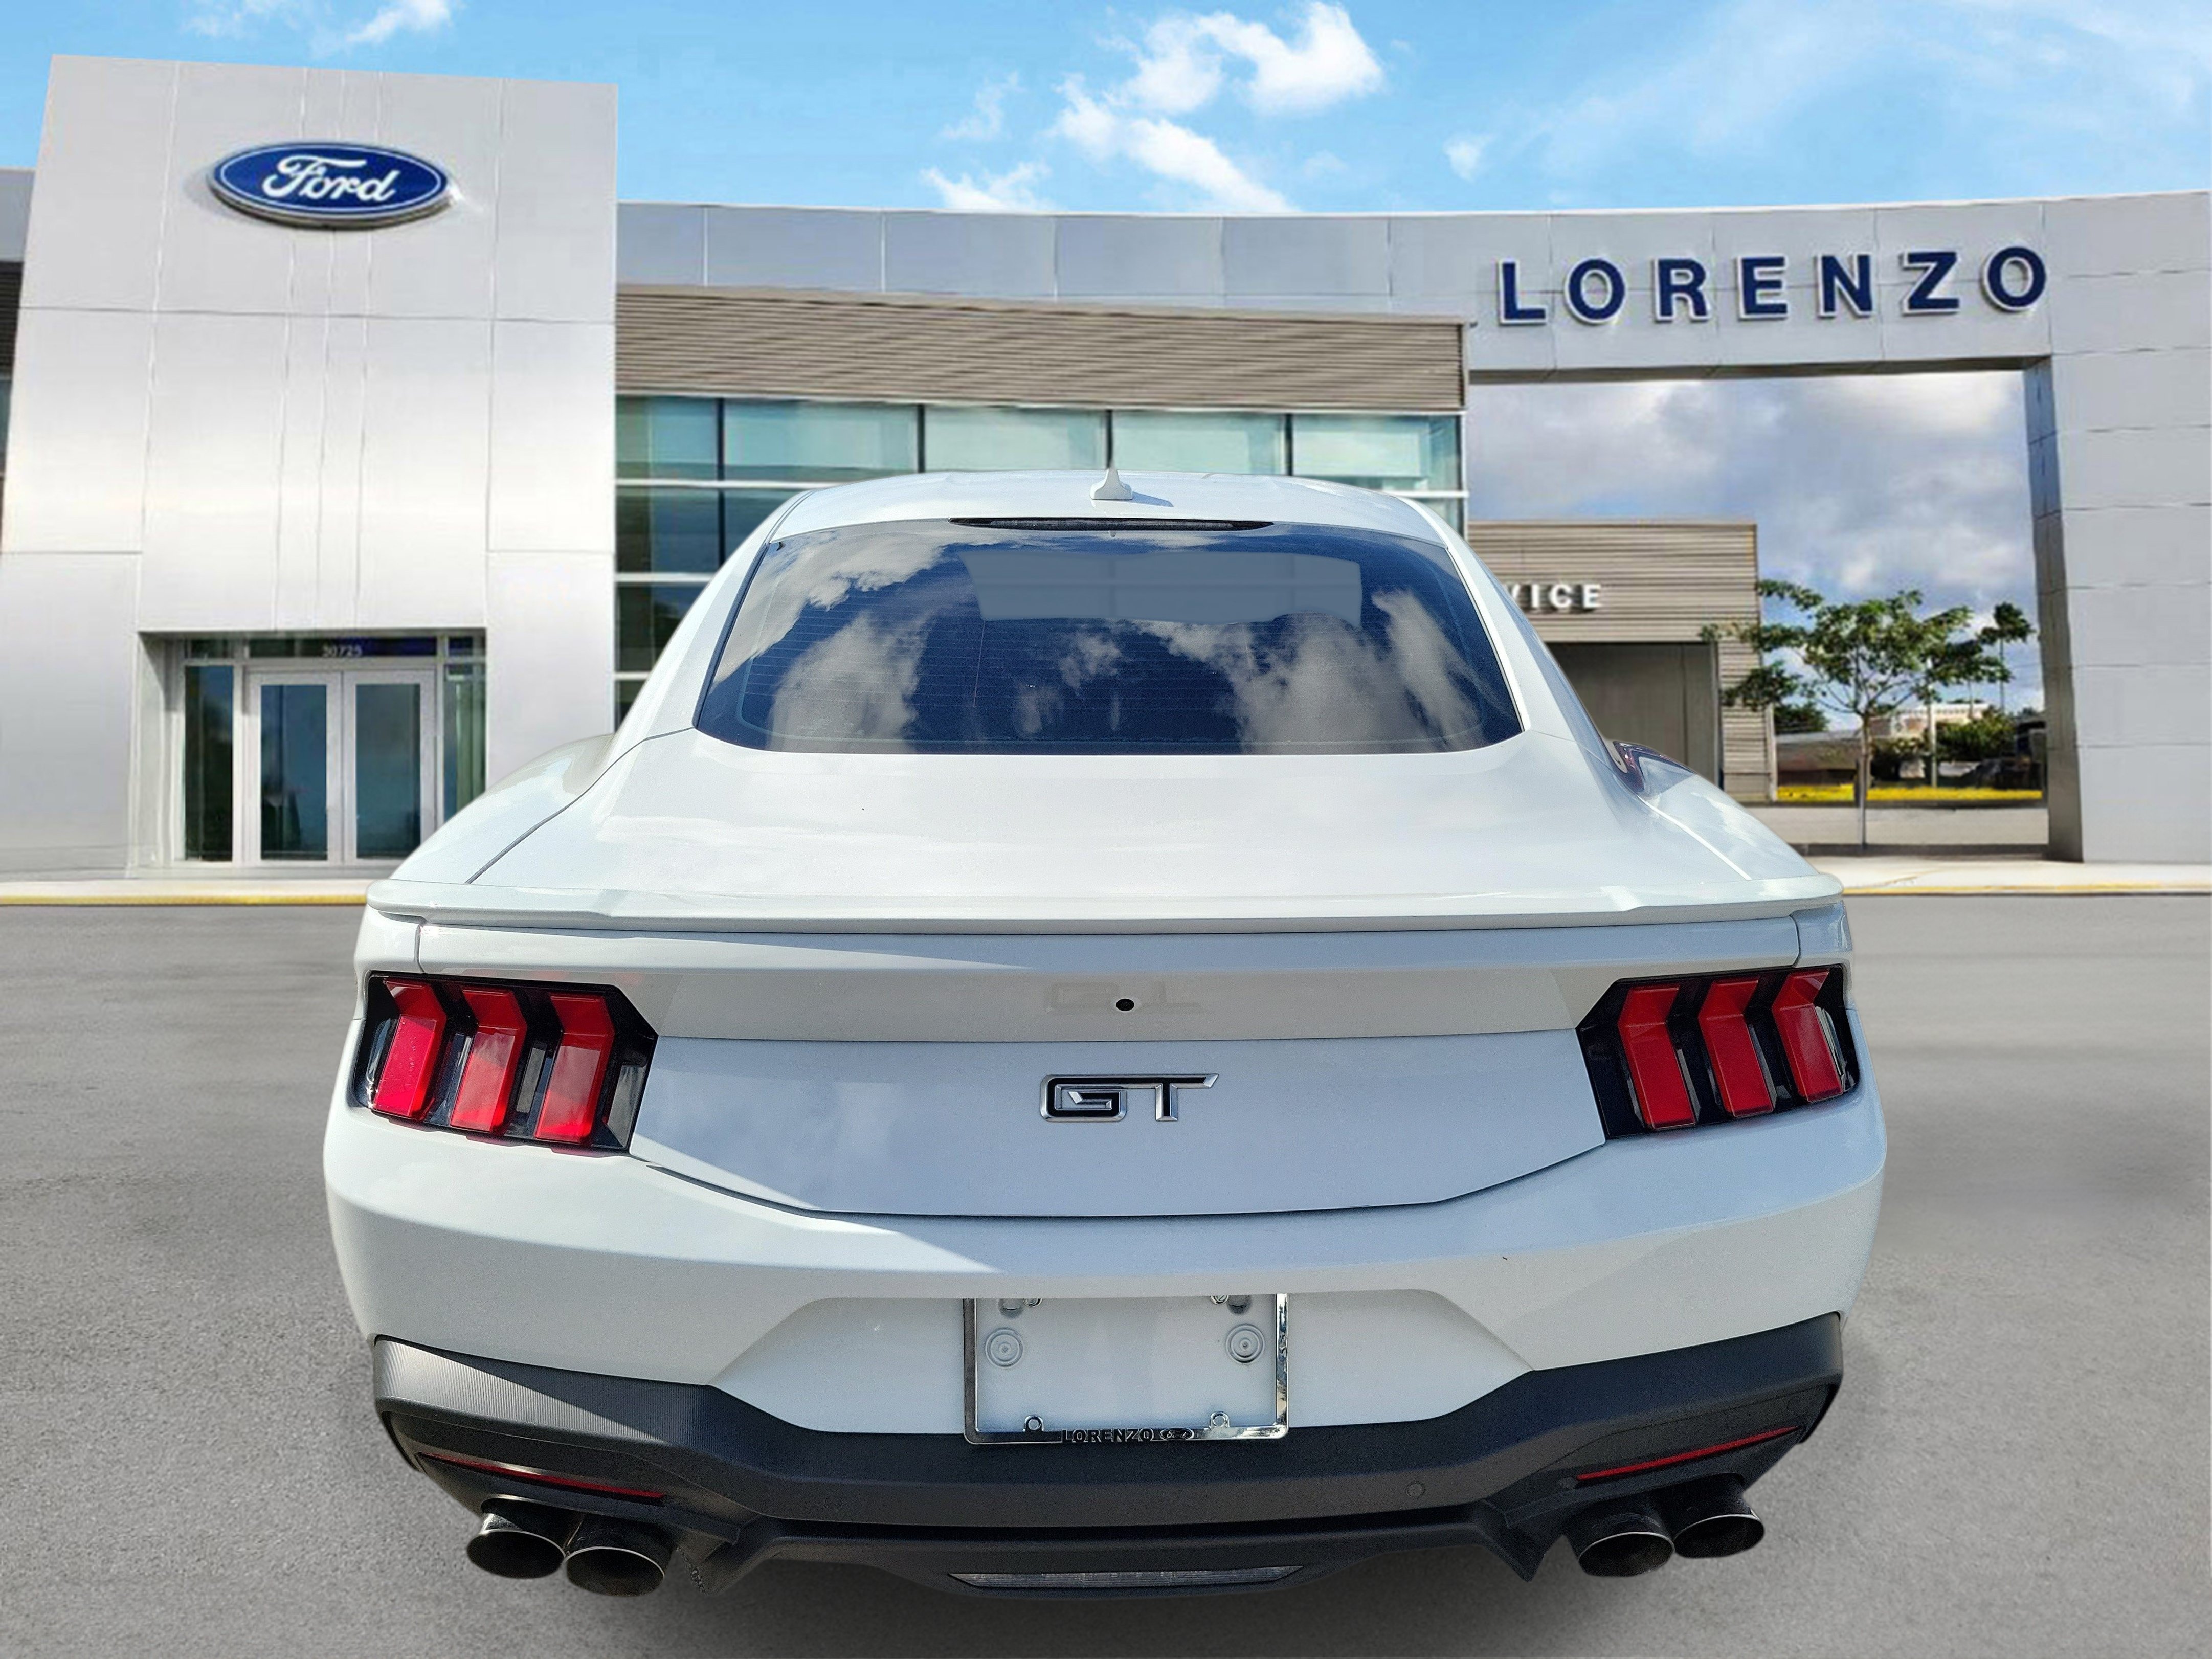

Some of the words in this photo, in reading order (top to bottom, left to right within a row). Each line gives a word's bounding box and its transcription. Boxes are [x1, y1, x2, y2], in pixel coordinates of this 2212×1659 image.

[262, 154, 400, 202] Ford
[1498, 246, 2047, 324] LORENZO
[1040, 1074, 1219, 1122] GT
[1061, 1428, 1154, 1443] LORENZO
